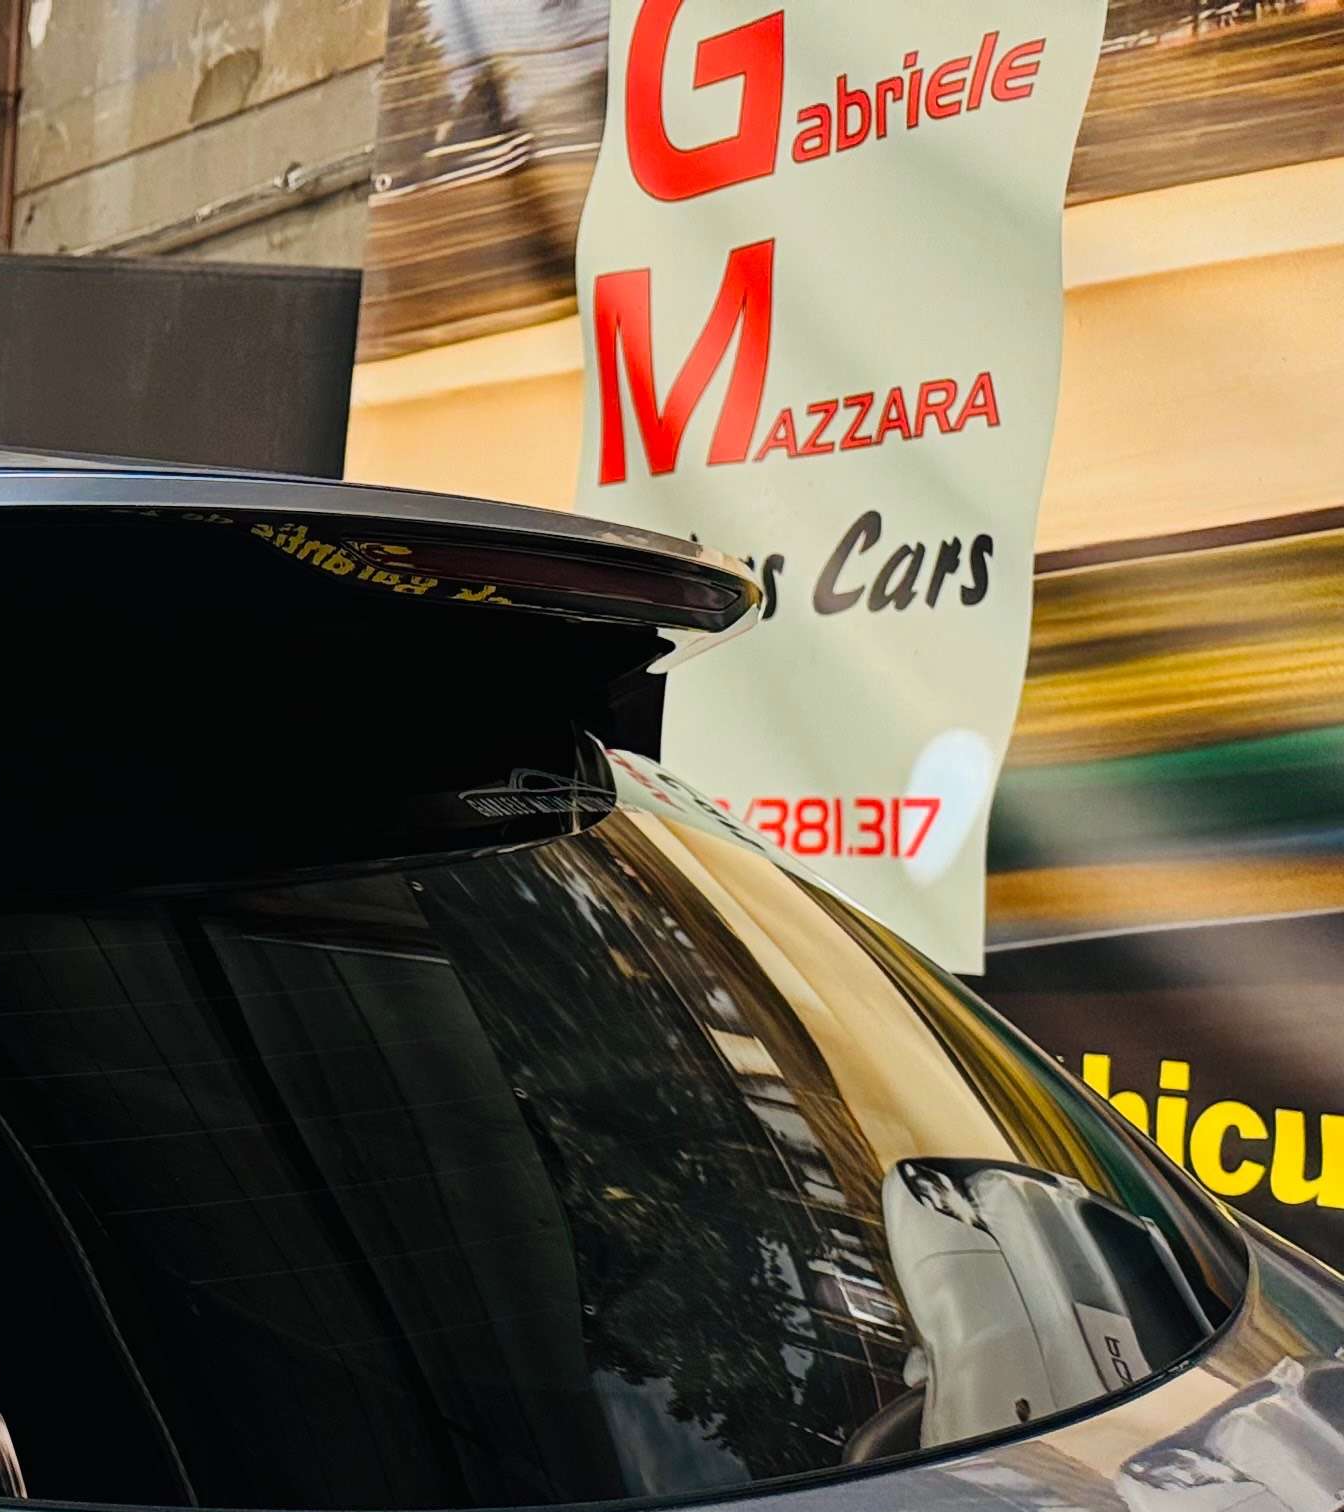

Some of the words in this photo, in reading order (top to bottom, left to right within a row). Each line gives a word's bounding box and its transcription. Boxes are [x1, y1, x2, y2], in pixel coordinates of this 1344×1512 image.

[594, 237, 1001, 488] MAZZARA
[812, 509, 994, 616] Cars
[712, 796, 942, 859] /381.317
